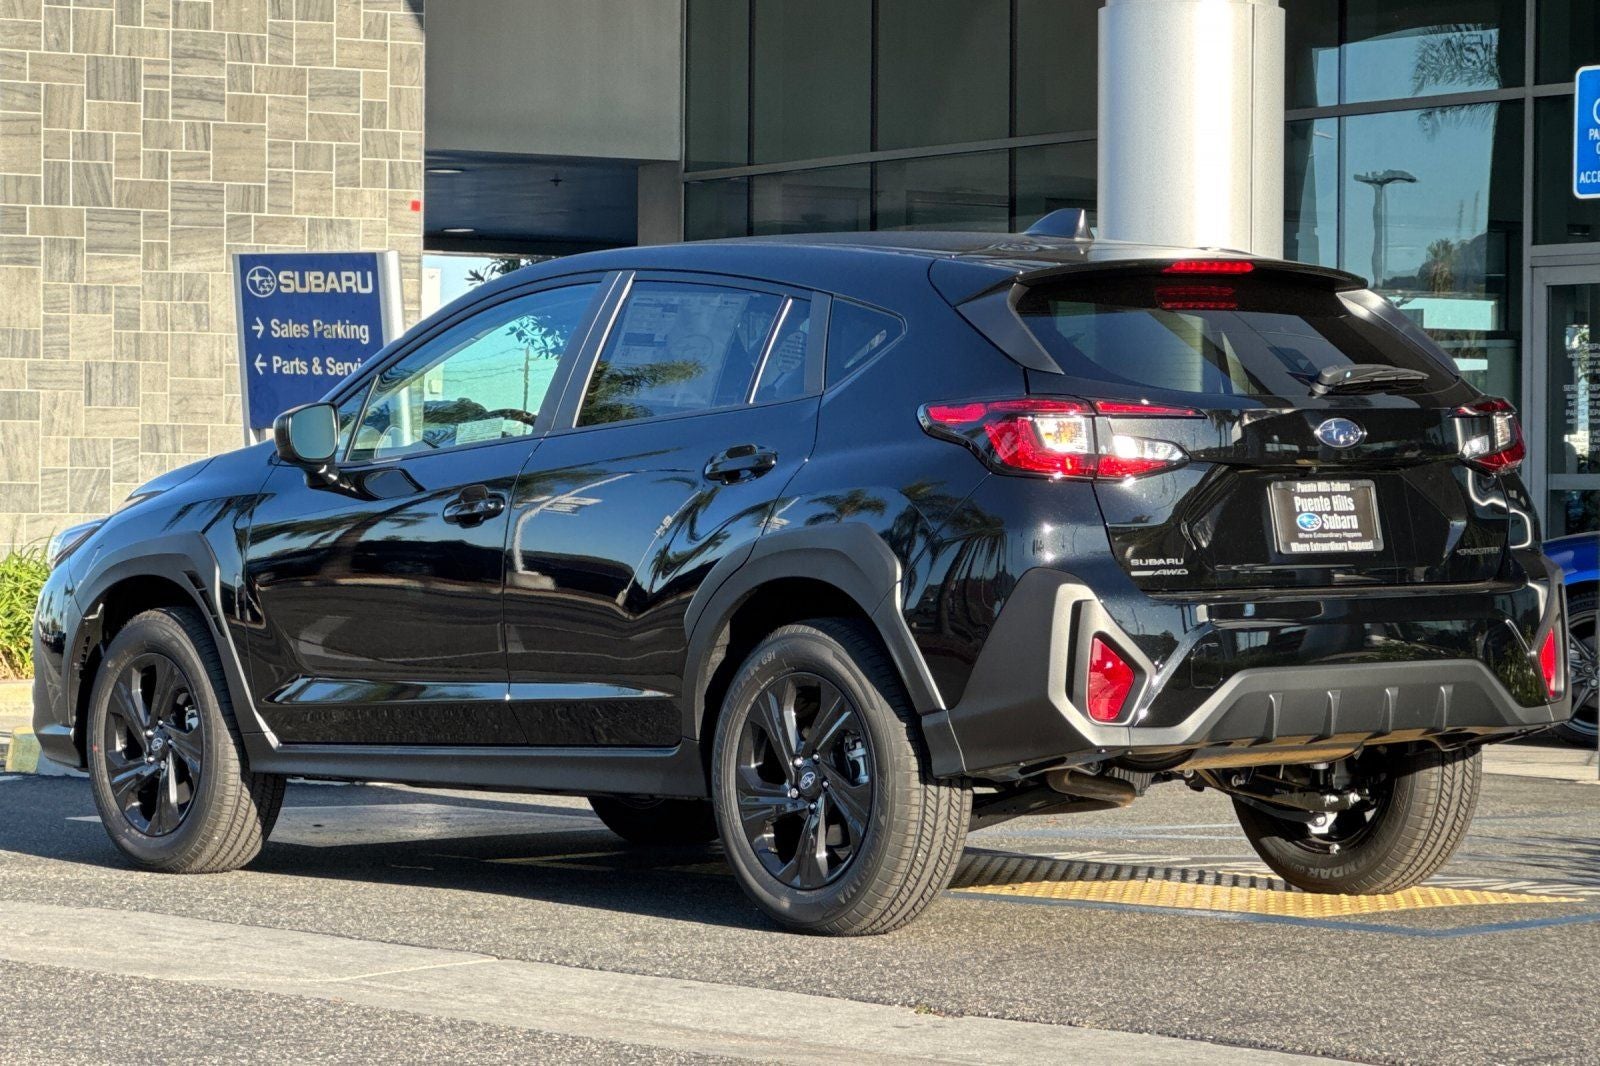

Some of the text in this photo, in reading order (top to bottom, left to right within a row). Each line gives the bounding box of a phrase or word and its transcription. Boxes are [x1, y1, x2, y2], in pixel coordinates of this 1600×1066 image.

[278, 270, 374, 294] SUBARU
[270, 318, 370, 345] Sales Parking
[272, 355, 309, 375] Parts
[311, 357, 323, 376] &
[1296, 481, 1351, 493] Puente Hills Subaru
[1293, 494, 1355, 512] Puente Hills
[1321, 513, 1359, 530] Subaru
[1290, 542, 1310, 552] Where
[1310, 541, 1348, 552] Extraordinary
[1130, 558, 1184, 566] SUBARU
[1152, 568, 1189, 576] AWD
